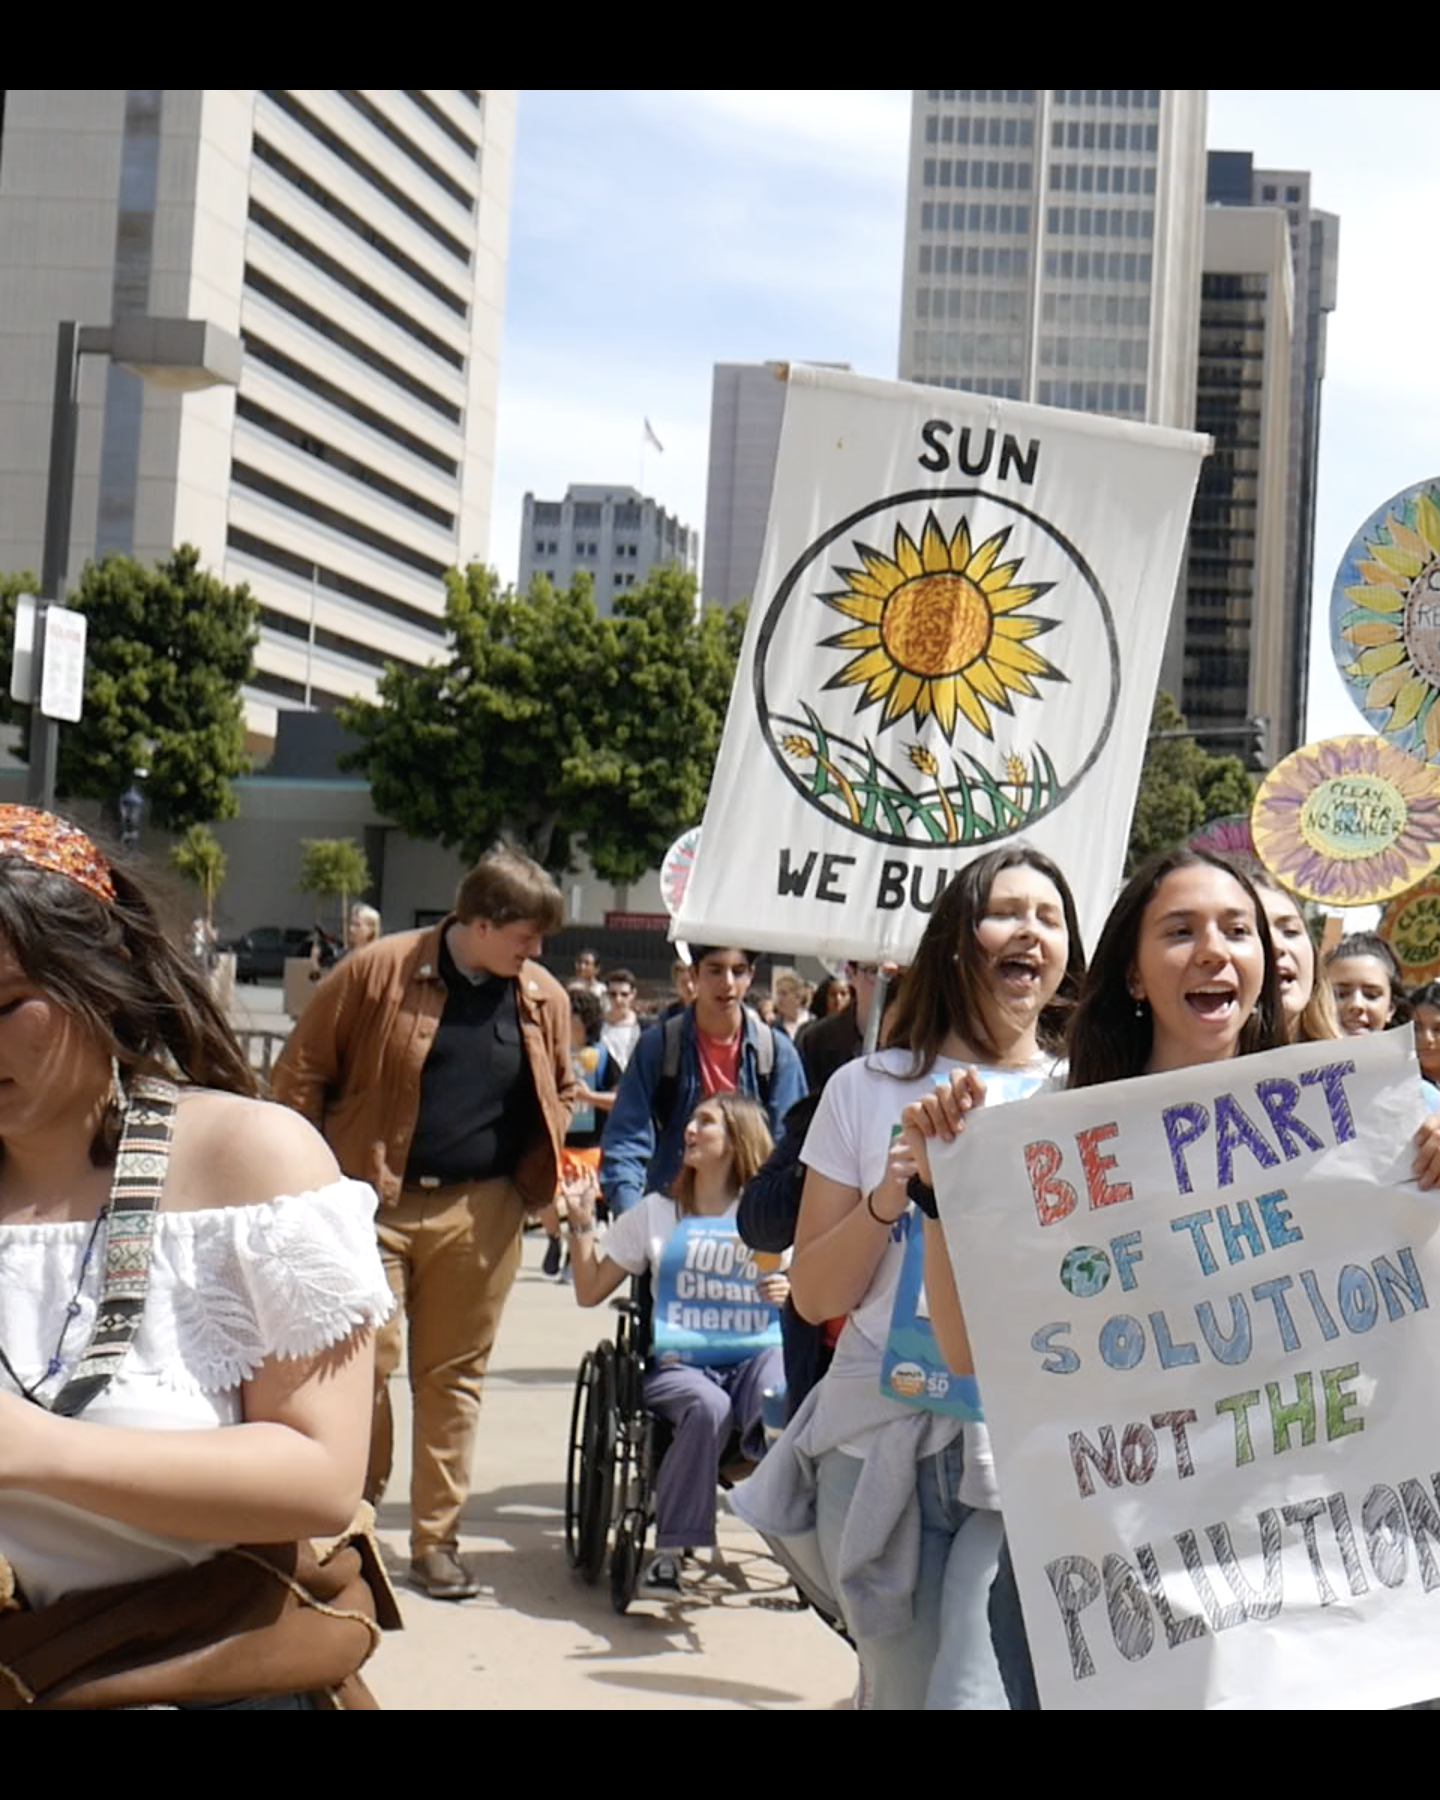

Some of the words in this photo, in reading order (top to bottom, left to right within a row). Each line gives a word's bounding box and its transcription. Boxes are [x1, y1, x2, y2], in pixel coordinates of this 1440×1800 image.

[918, 419, 1041, 486] SUN
[1306, 811, 1330, 830] NO
[777, 848, 857, 904] WE
[876, 859, 956, 913] BU
[1024, 1121, 1134, 1228] BE
[1161, 1059, 1358, 1195] PART
[685, 1238, 758, 1280] 100%
[1059, 1230, 1145, 1299] OF
[1170, 1188, 1303, 1277] THE
[666, 1301, 769, 1333] Energy
[676, 1270, 761, 1303] Clean
[1031, 1246, 1430, 1375] SOLUTION
[1067, 1408, 1198, 1498] NOT
[1214, 1361, 1366, 1469] THE
